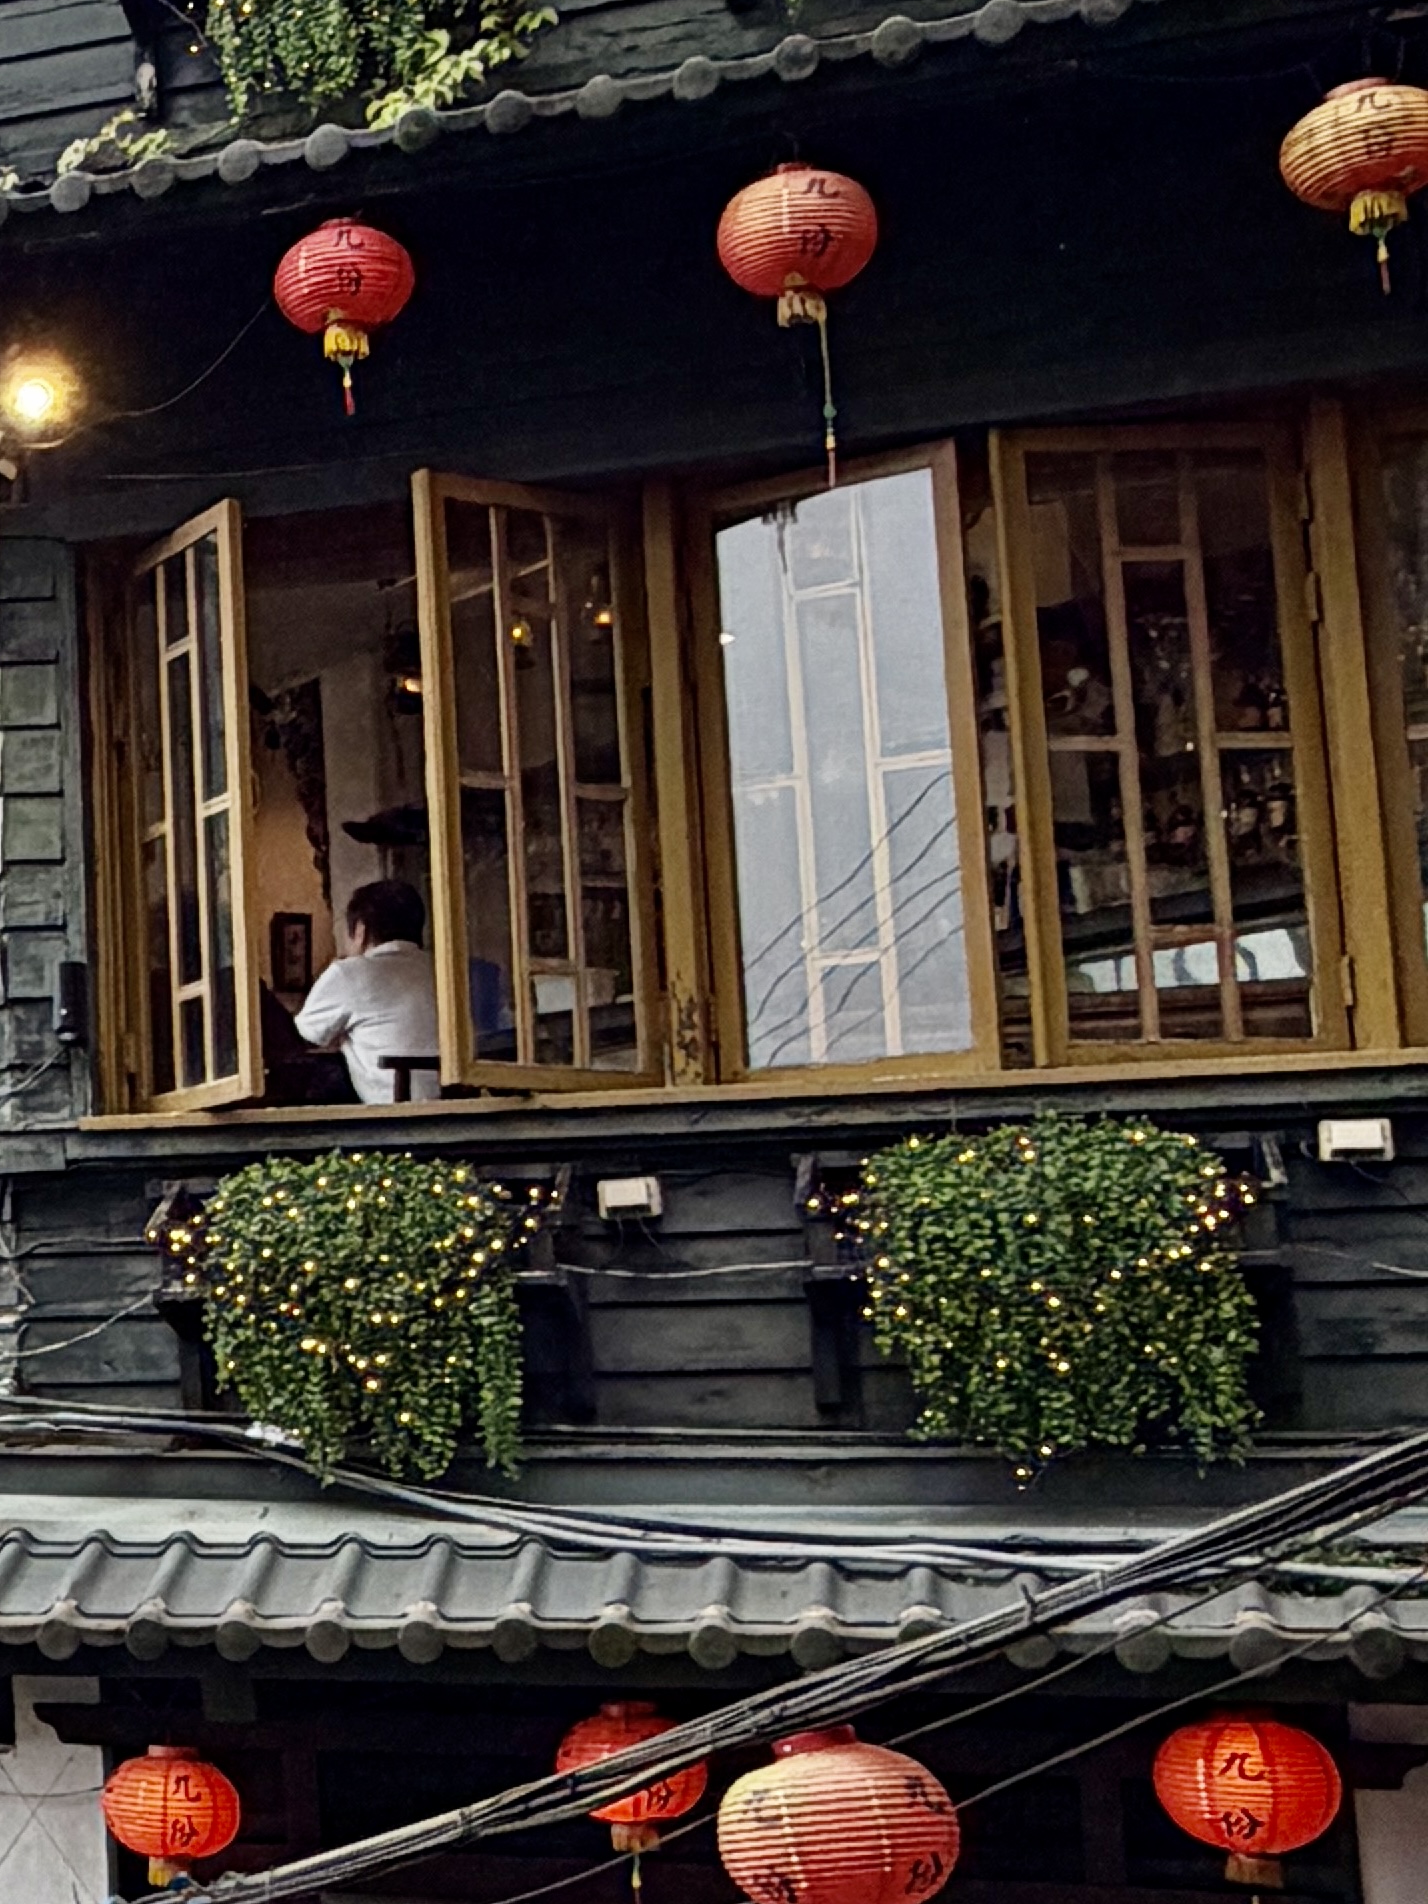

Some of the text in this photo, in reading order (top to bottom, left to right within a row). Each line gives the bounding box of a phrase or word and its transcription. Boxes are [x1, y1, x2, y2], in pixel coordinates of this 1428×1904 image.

[798, 177, 841, 258] 九份
[332, 227, 366, 297] 九份
[171, 1775, 201, 1846] 九份
[904, 1775, 945, 1895] 九份
[1217, 1751, 1266, 1840] 九份
